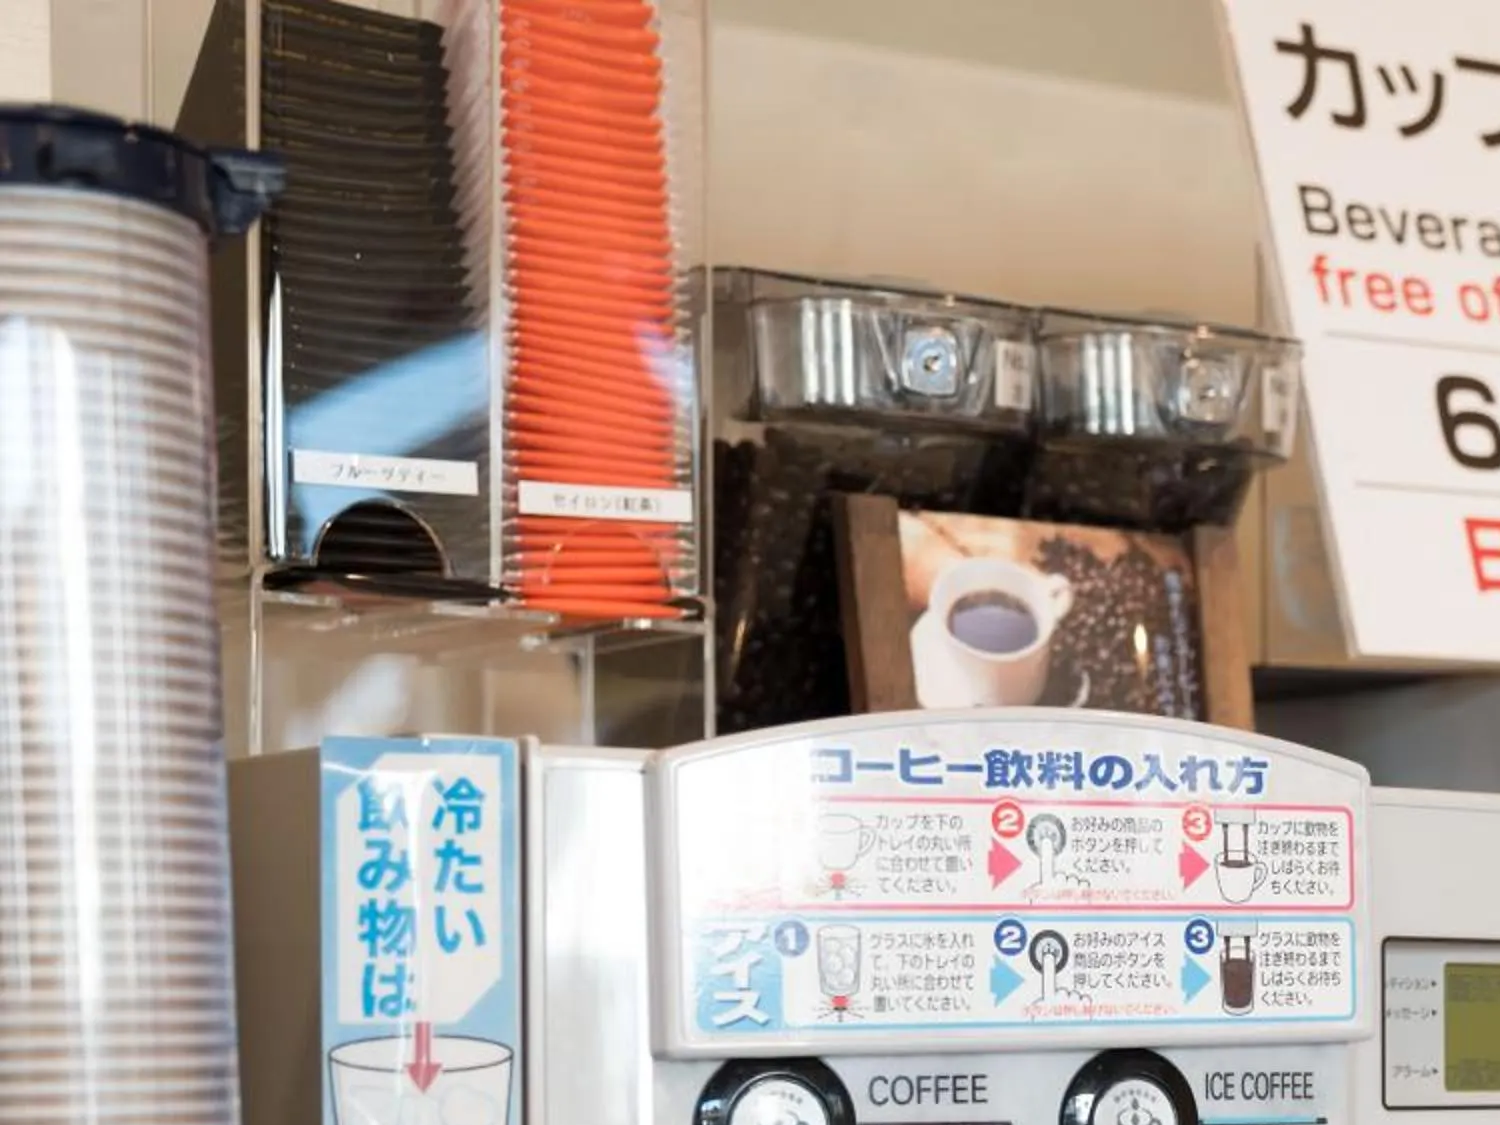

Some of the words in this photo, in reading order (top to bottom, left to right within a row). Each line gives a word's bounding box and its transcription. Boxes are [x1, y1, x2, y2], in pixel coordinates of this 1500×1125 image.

[1312, 254, 1434, 317] free
[811, 748, 1268, 793] コーヒー飲料の入れ方
[996, 806, 1021, 836] 2
[1185, 809, 1209, 837] 3
[432, 777, 486, 954] 冷たい
[1072, 857, 1131, 874] ください。
[878, 877, 958, 894] てください。
[998, 923, 1023, 951] 2
[1073, 931, 1167, 949] お好みのアイス
[1188, 922, 1210, 951] 3
[1073, 972, 1173, 990] 押してください。
[868, 1074, 989, 1107] COFFEE
[1205, 1072, 1236, 1101] ICE
[1241, 1071, 1316, 1100] COFFEE
